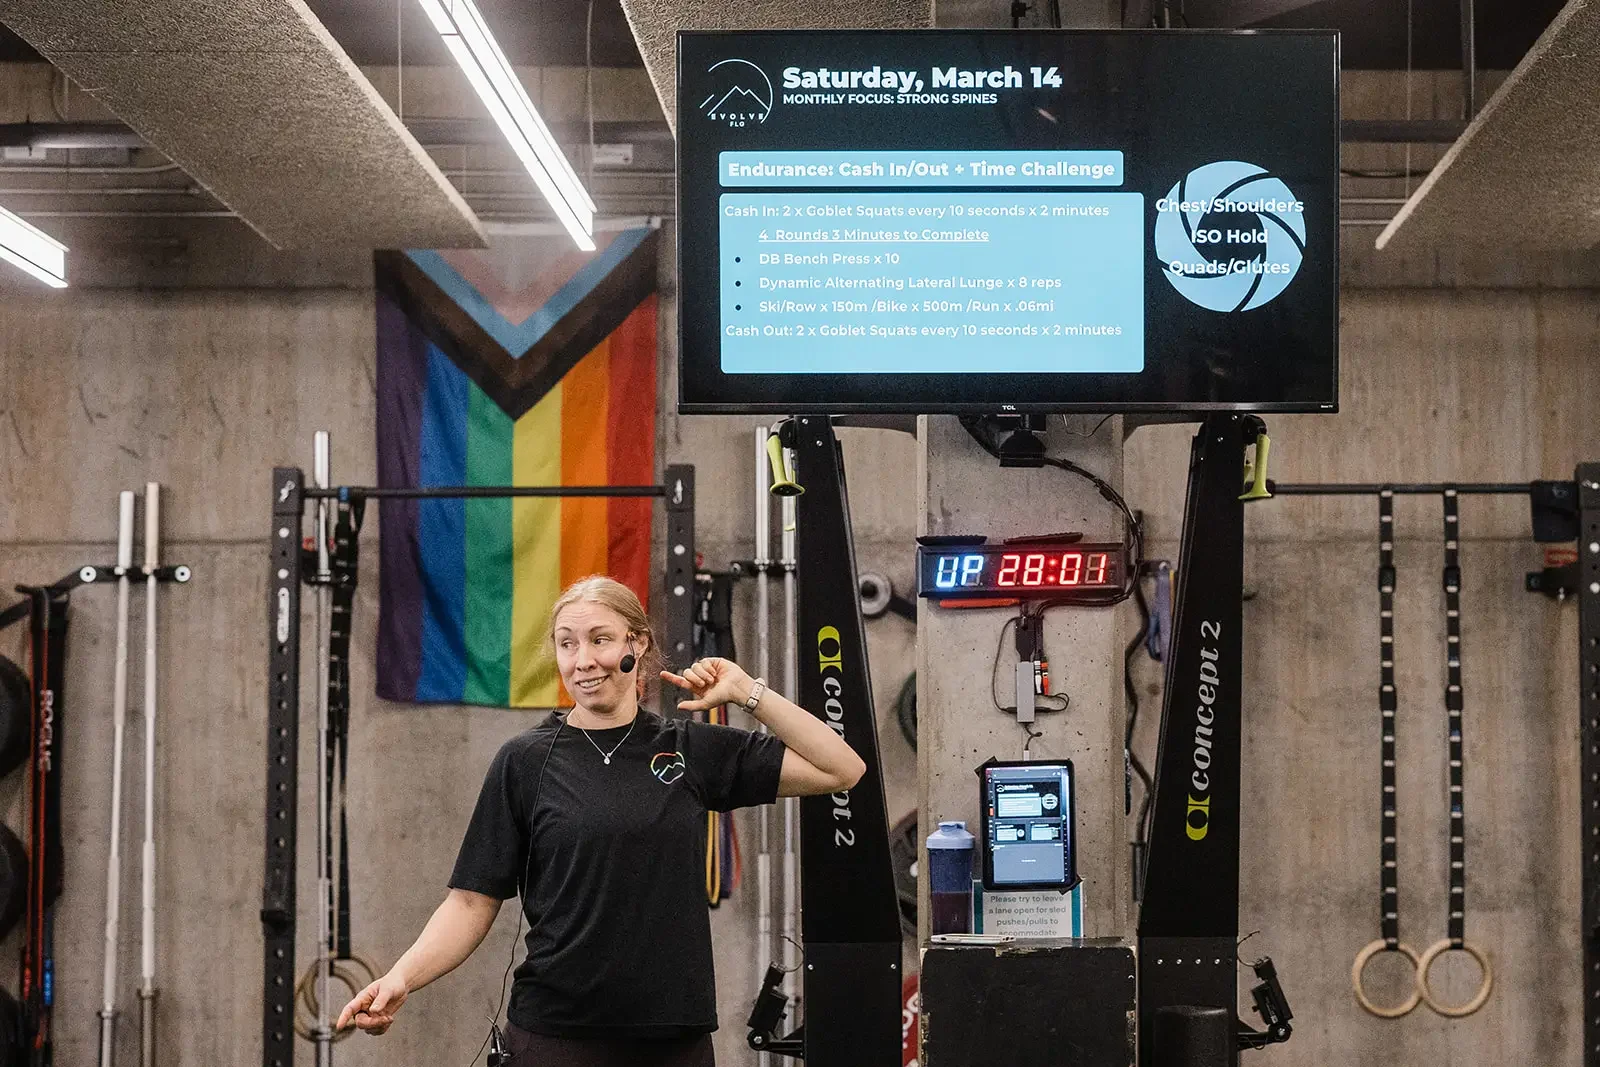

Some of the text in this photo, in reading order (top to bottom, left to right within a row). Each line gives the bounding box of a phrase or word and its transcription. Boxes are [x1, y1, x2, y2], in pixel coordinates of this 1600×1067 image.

[782, 66, 1063, 94] Saturday, March 14
[783, 94, 998, 105] MONTHLY FOCUS: STRONG SPINES
[728, 161, 1115, 180] Endurance: Cash In/Out + Time Challenge
[725, 205, 1110, 219] Cash In: 2 x Goblet Squats every 10 seconds x 2 minutes
[1155, 198, 1304, 214] Chest/Shoulders
[758, 228, 990, 242] 4 Rounds 3 Minutes to Complete
[1191, 229, 1269, 244] ISO Hold
[759, 253, 900, 265] DB Bench Press x 10
[1168, 259, 1290, 276] Quads/Glutes
[759, 277, 1062, 291] Dynamic Alternating Lateral Lunge x 8 reps
[759, 299, 1054, 313] Ski/Row x 150m /Bike x 500m /Run x .06mi
[725, 325, 1122, 339] Cash Out: 2 x Goblet Squats every 10 seconds x 2 minutes
[936, 553, 1107, 588] UP 28:01
[1191, 619, 1222, 791] concept 2
[823, 676, 855, 848] conpt 2
[990, 895, 1017, 903] Please
[1018, 895, 1030, 904] try
[1042, 894, 1064, 902] leave
[1013, 908, 1035, 916] open
[1036, 906, 1048, 914] for
[1049, 905, 1067, 914] sled
[996, 917, 1049, 928] pushes/pulls
[998, 929, 1058, 937] accommodate
